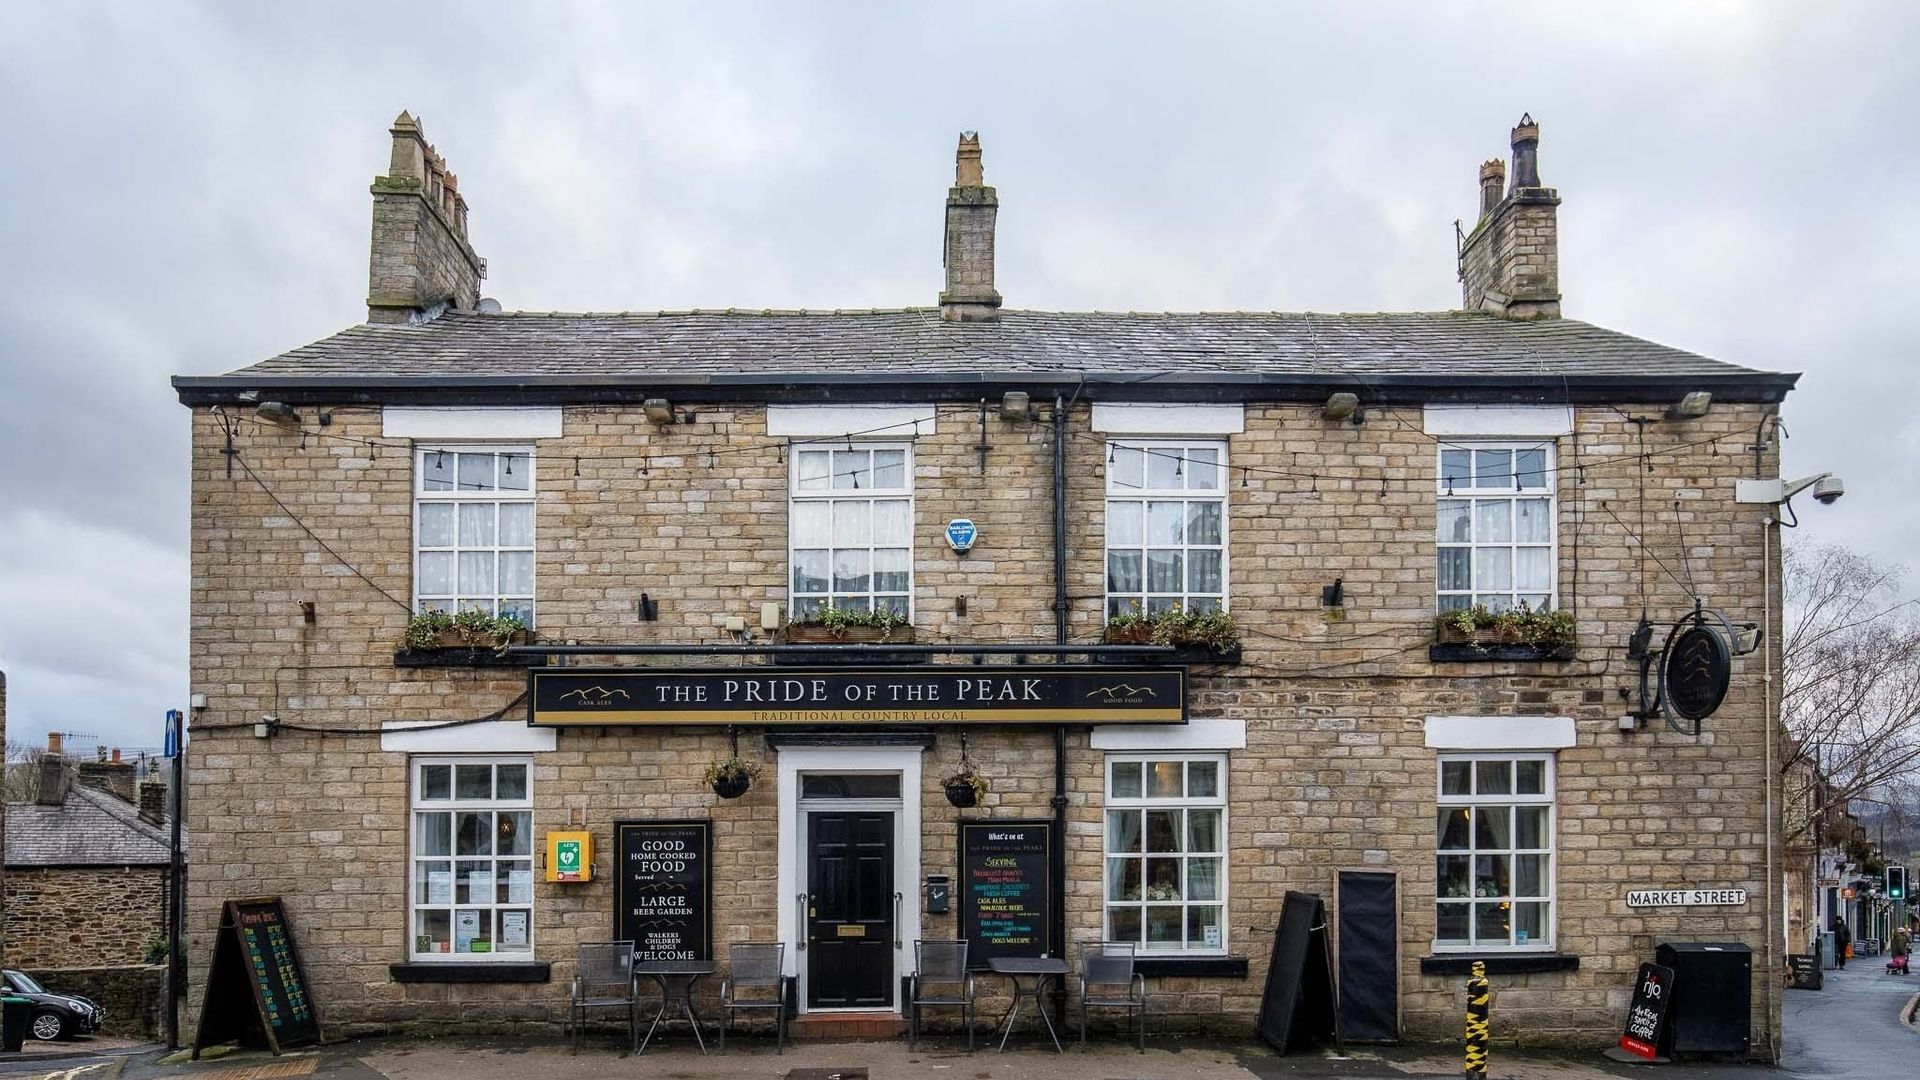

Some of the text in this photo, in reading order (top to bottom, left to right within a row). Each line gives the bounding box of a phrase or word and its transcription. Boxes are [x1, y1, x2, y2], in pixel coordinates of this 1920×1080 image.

[655, 679, 1042, 702] THE PRIDE OF THE PEAK
[751, 710, 967, 721] TRADITIONAL COUNTRY LOCAL
[641, 840, 685, 852] GOOD
[630, 852, 697, 860] HOME COOKED
[641, 860, 686, 873] FOOD
[641, 896, 686, 907] LARGE
[1629, 891, 1686, 905] MARKET
[1694, 890, 1743, 903] STREET
[633, 907, 693, 916] BEER GARDEN
[633, 950, 695, 960] WELCOME
